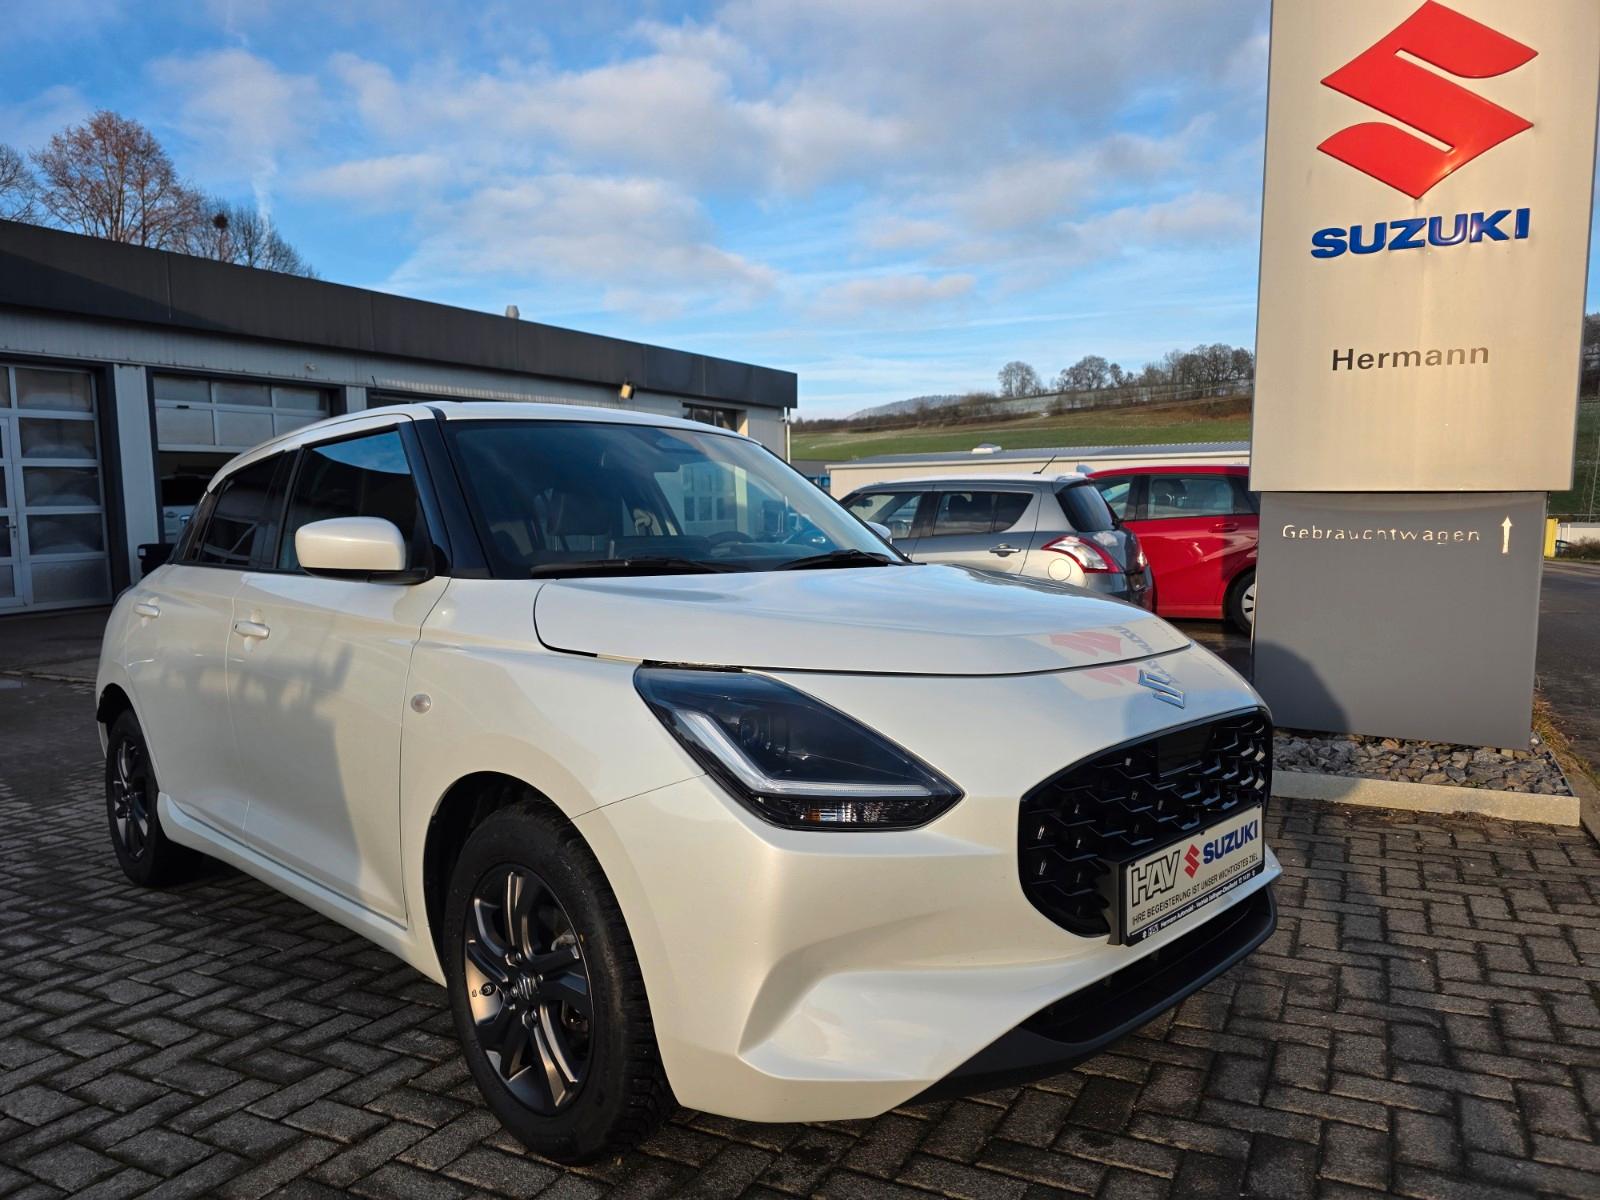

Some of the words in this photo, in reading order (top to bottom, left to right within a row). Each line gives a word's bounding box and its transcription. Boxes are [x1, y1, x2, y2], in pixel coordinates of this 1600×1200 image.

[1311, 208, 1530, 258] SUZUKI
[1332, 346, 1489, 370] Hermann
[1282, 524, 1481, 545] Gebrauchtwagen
[1131, 850, 1181, 907] HAV
[1203, 819, 1258, 865] SUZUKI
[1132, 910, 1147, 926] IHRE
[1147, 889, 1191, 918] BEGEISTERUNG
[1191, 884, 1200, 895] IST
[1201, 874, 1218, 890] UNSER
[1218, 857, 1248, 880] WICHTIGSTES
